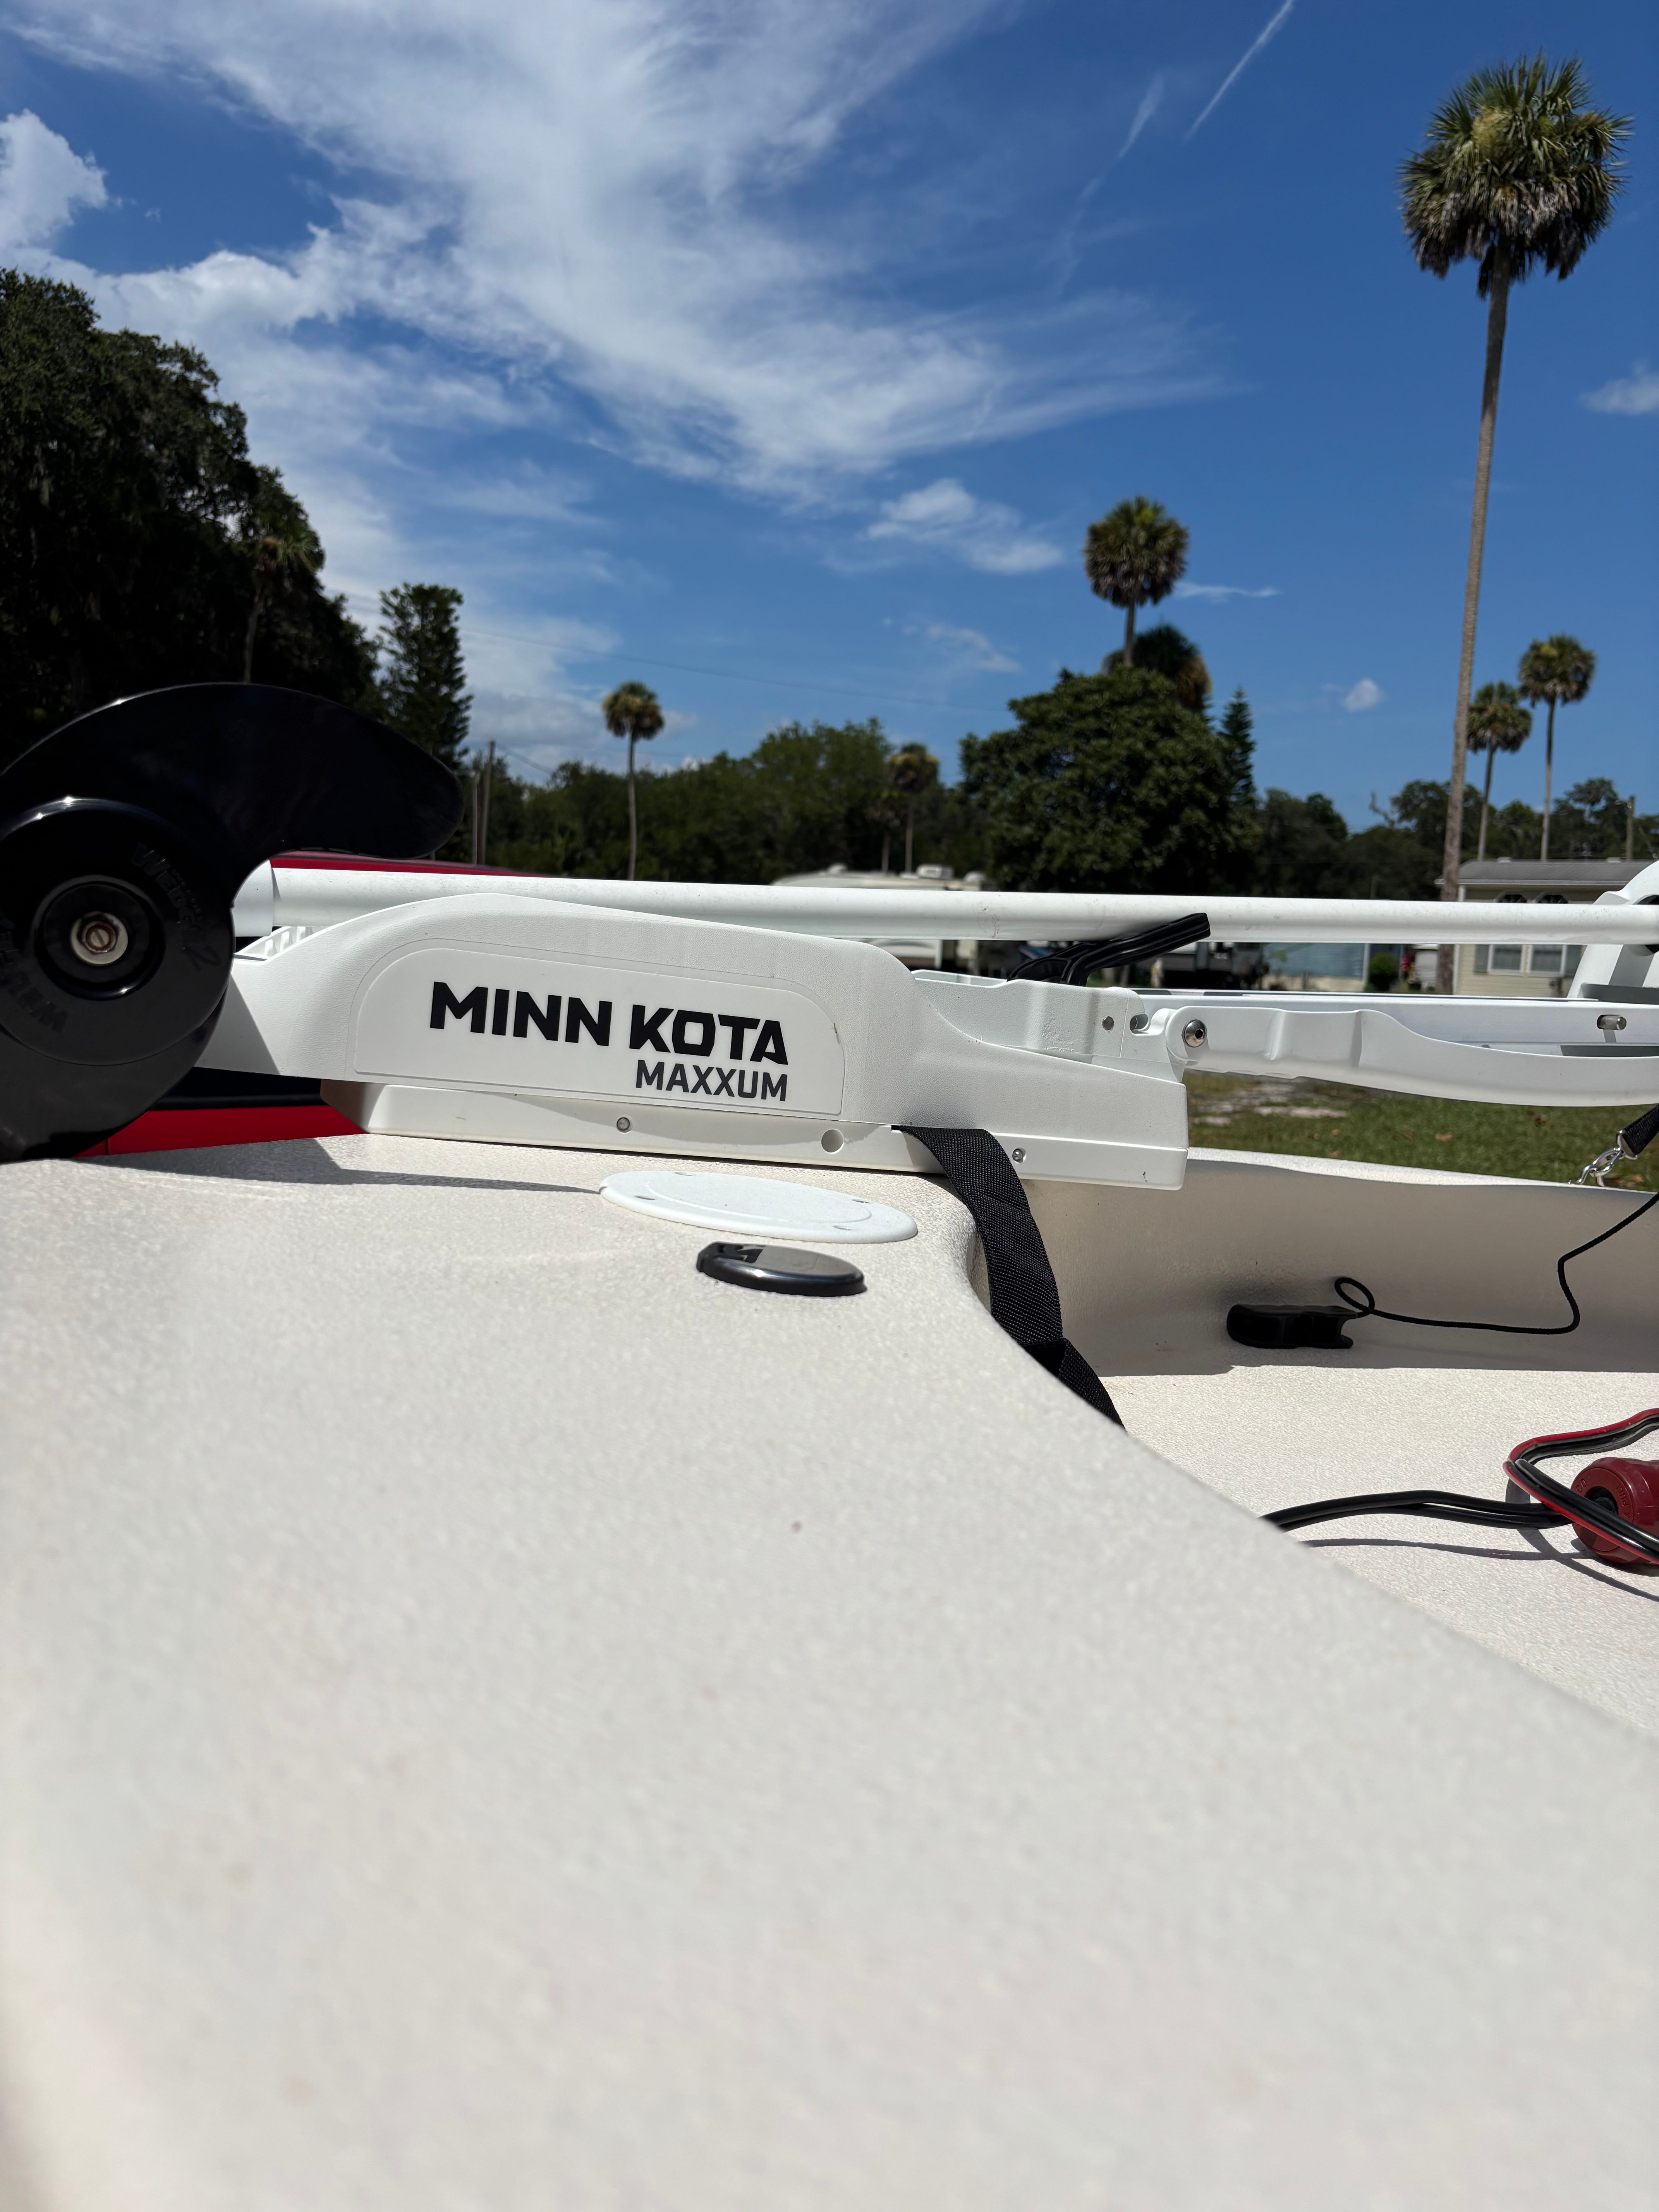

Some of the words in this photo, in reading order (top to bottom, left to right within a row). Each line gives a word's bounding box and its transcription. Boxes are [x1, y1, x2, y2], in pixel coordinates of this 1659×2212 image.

[430, 981, 612, 1046] MINN
[629, 1004, 788, 1065] KOTA
[636, 1060, 788, 1101] MAXXUM
[1616, 1482, 1629, 1507] PULL
